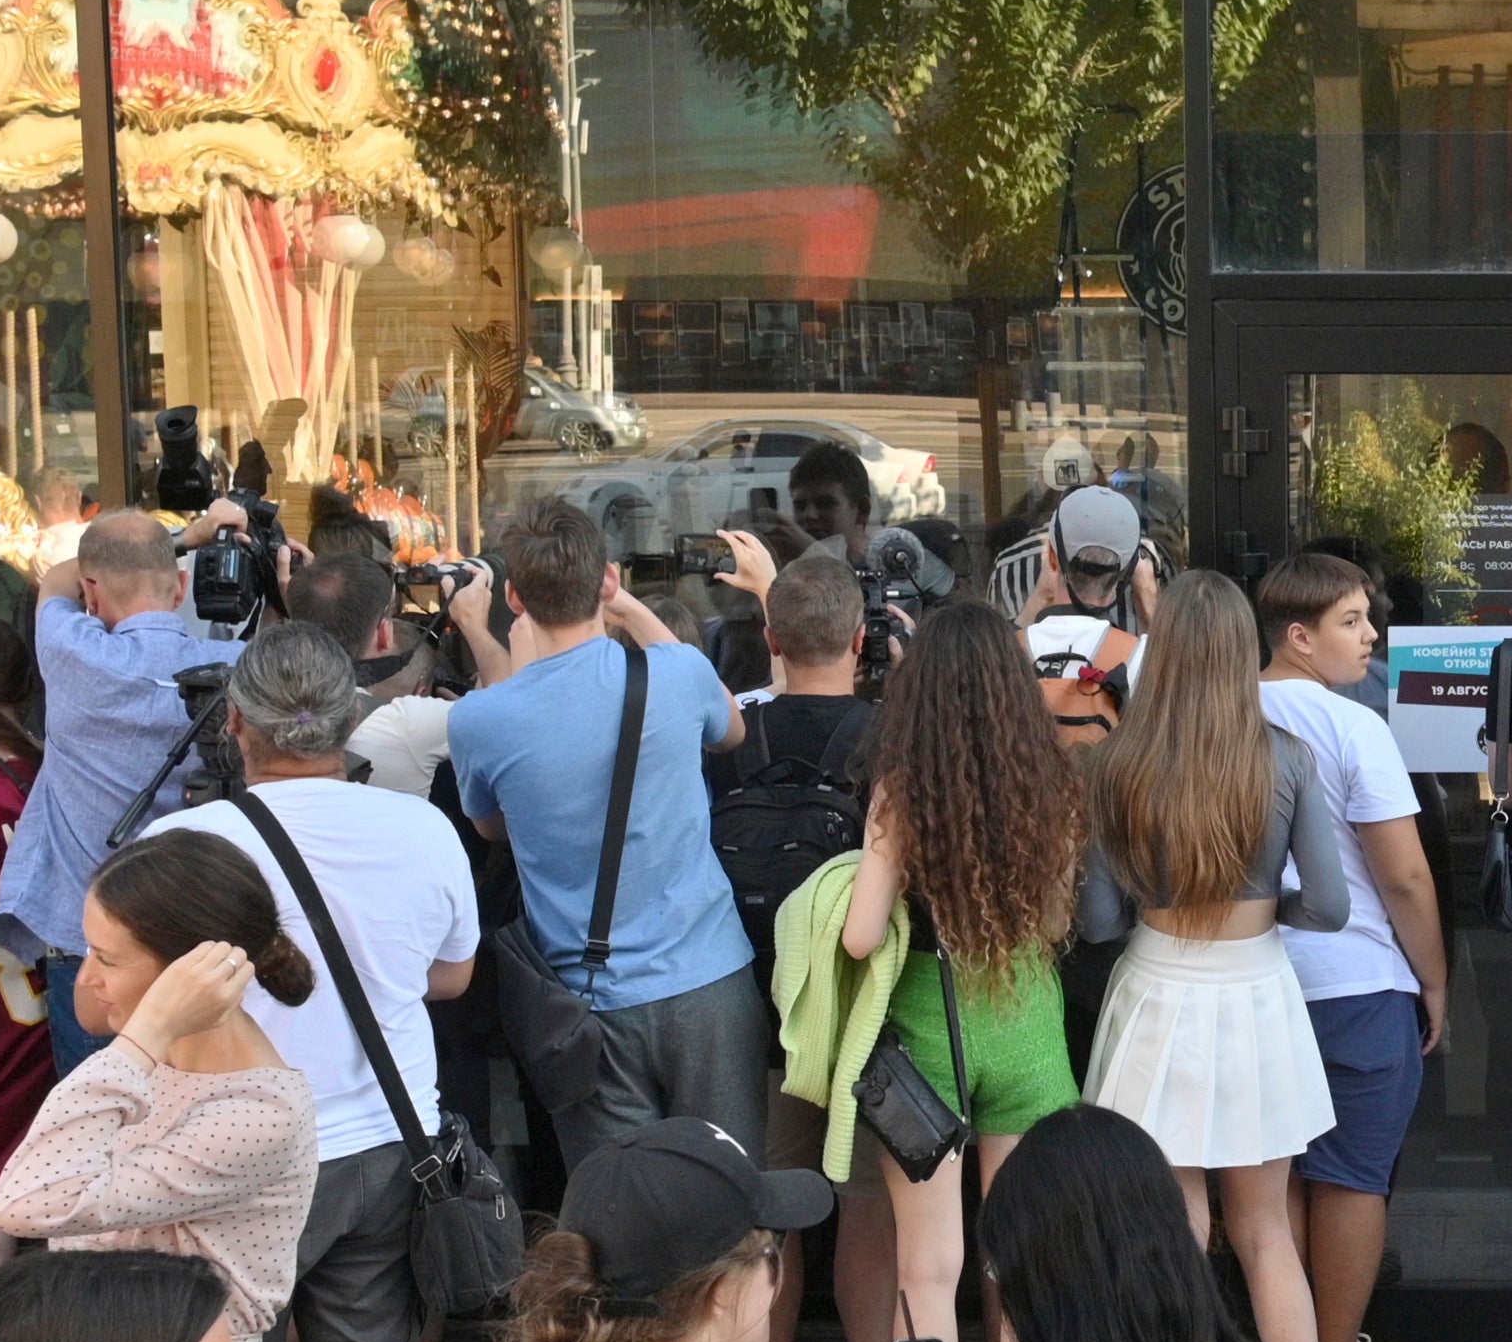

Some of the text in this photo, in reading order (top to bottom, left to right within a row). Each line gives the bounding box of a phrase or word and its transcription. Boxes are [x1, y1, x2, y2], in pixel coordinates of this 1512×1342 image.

[1455, 541, 1486, 550] ЧАСЫ
[1413, 645, 1477, 658] КОФЕЙНЯ
[1444, 658, 1491, 669] ОТКРЫ
[1431, 685, 1489, 696] 19 АВГУС
